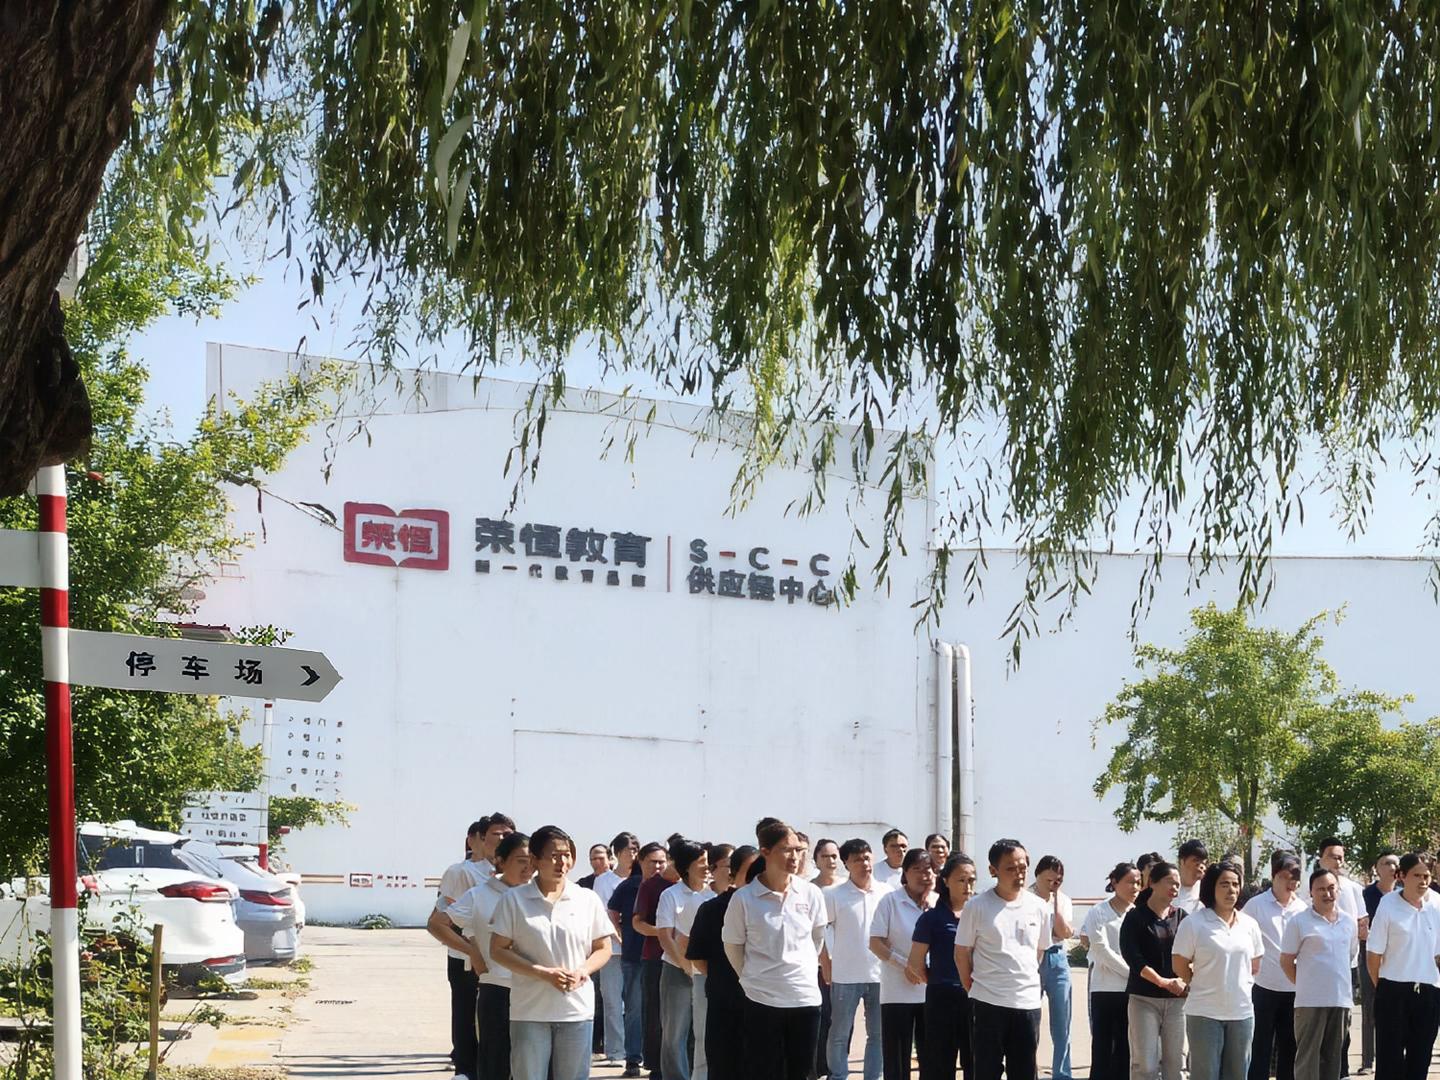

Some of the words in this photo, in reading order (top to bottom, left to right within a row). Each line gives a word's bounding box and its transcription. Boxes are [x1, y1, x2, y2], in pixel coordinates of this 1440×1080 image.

[475, 517, 652, 568] 荣恒教育
[126, 651, 263, 685] 停车场
